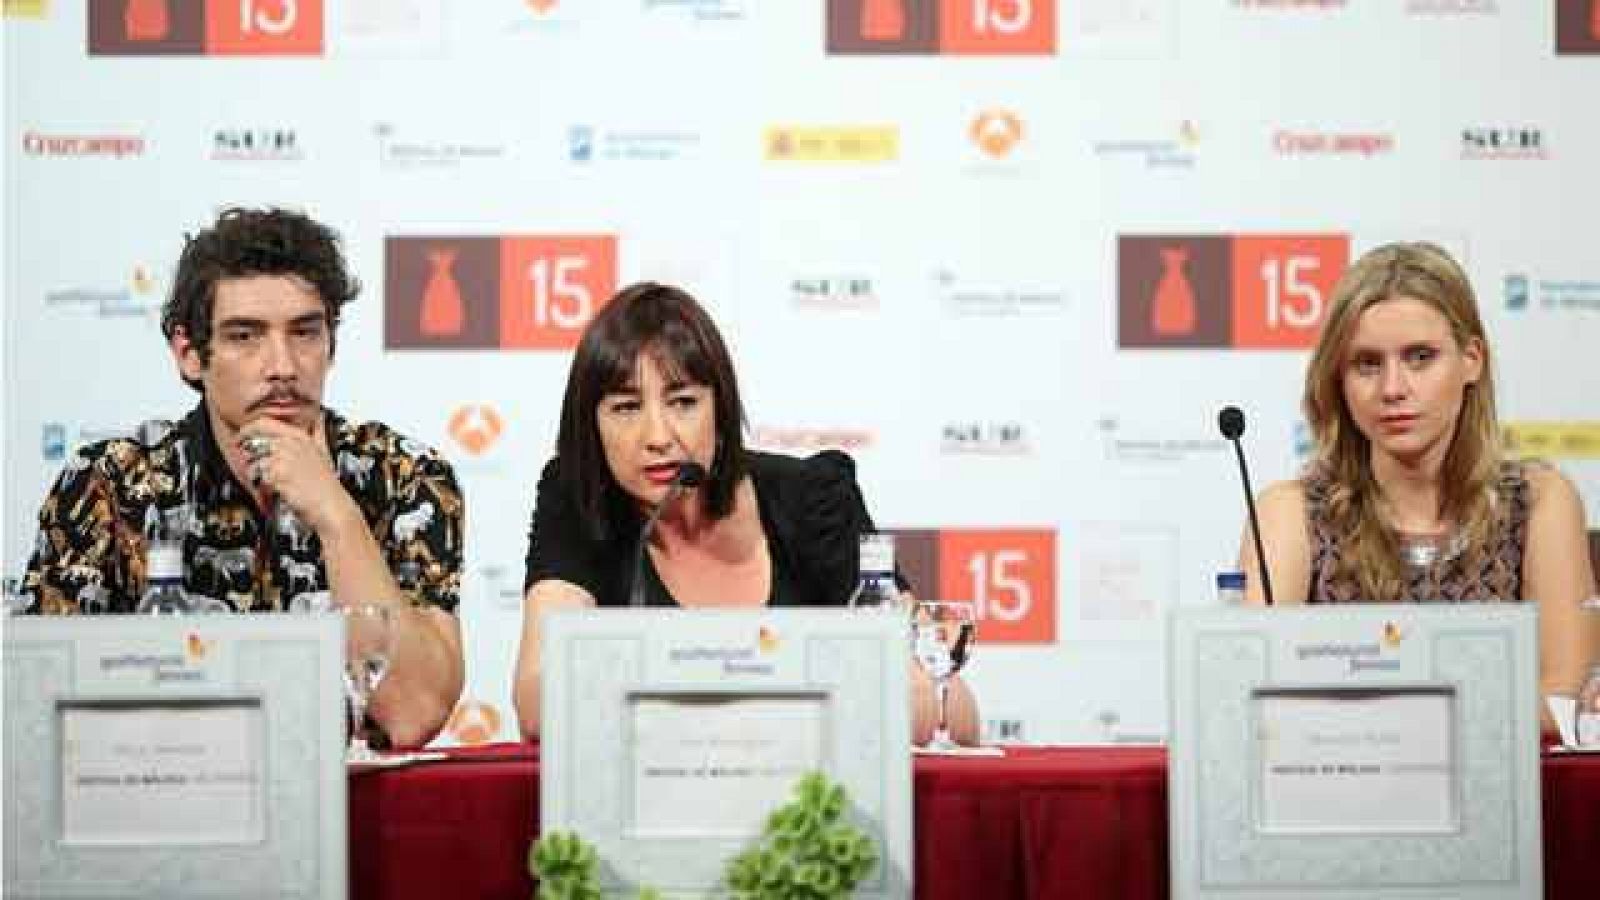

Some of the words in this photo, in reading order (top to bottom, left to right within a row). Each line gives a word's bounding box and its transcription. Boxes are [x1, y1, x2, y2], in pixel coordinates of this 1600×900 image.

[528, 257, 592, 328] 15
[1261, 257, 1322, 329] 15
[967, 552, 1031, 622] 15
